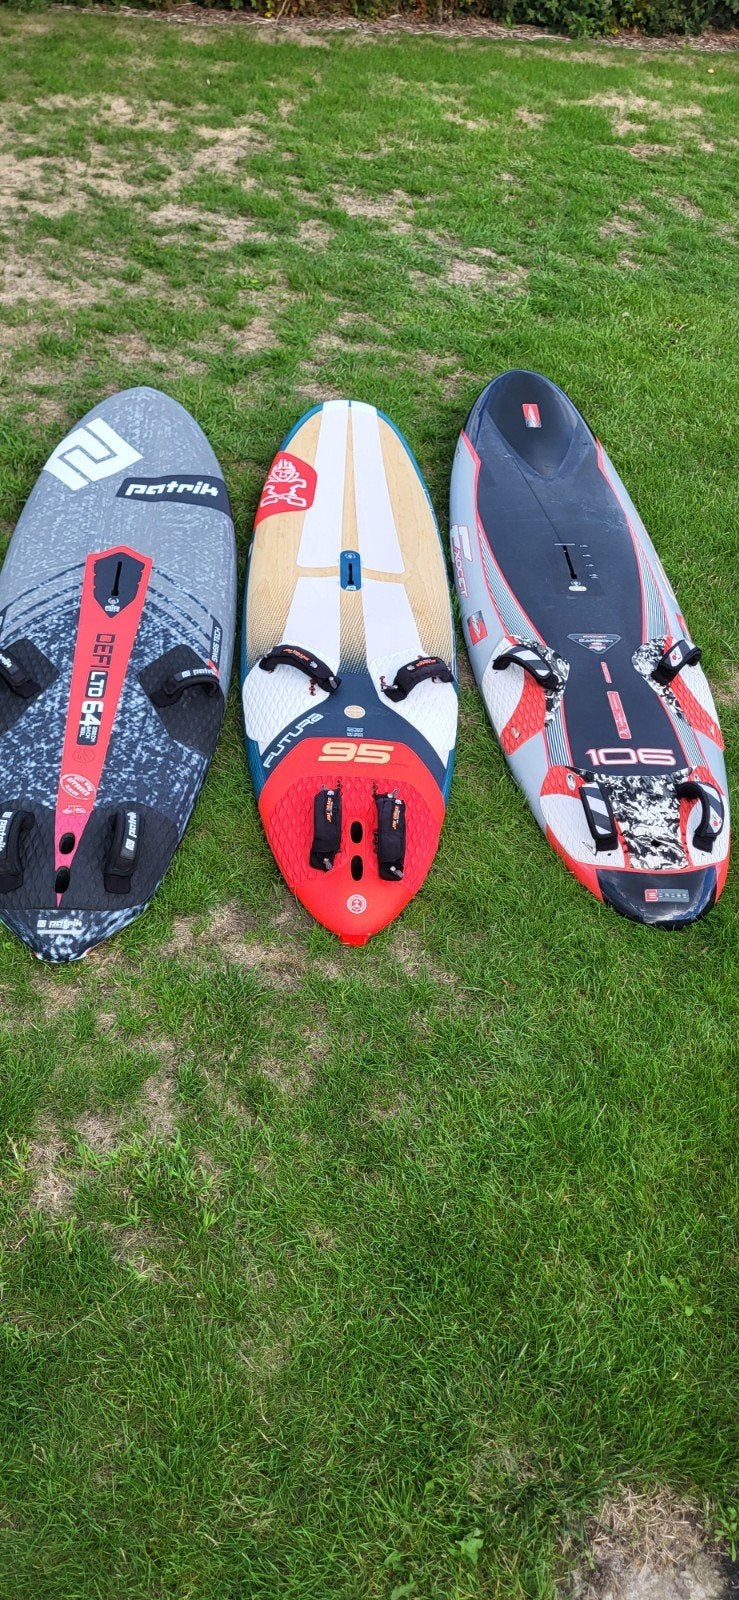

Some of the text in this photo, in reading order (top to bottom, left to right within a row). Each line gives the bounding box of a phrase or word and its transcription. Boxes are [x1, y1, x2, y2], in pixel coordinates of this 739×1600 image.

[124, 480, 219, 497] patrik
[90, 633, 116, 669] DEFI
[87, 671, 107, 697] LTD
[192, 667, 218, 677] patr
[79, 700, 104, 726] 64
[262, 712, 324, 769] FUTURA
[317, 741, 395, 764] 95
[585, 747, 677, 767] 106
